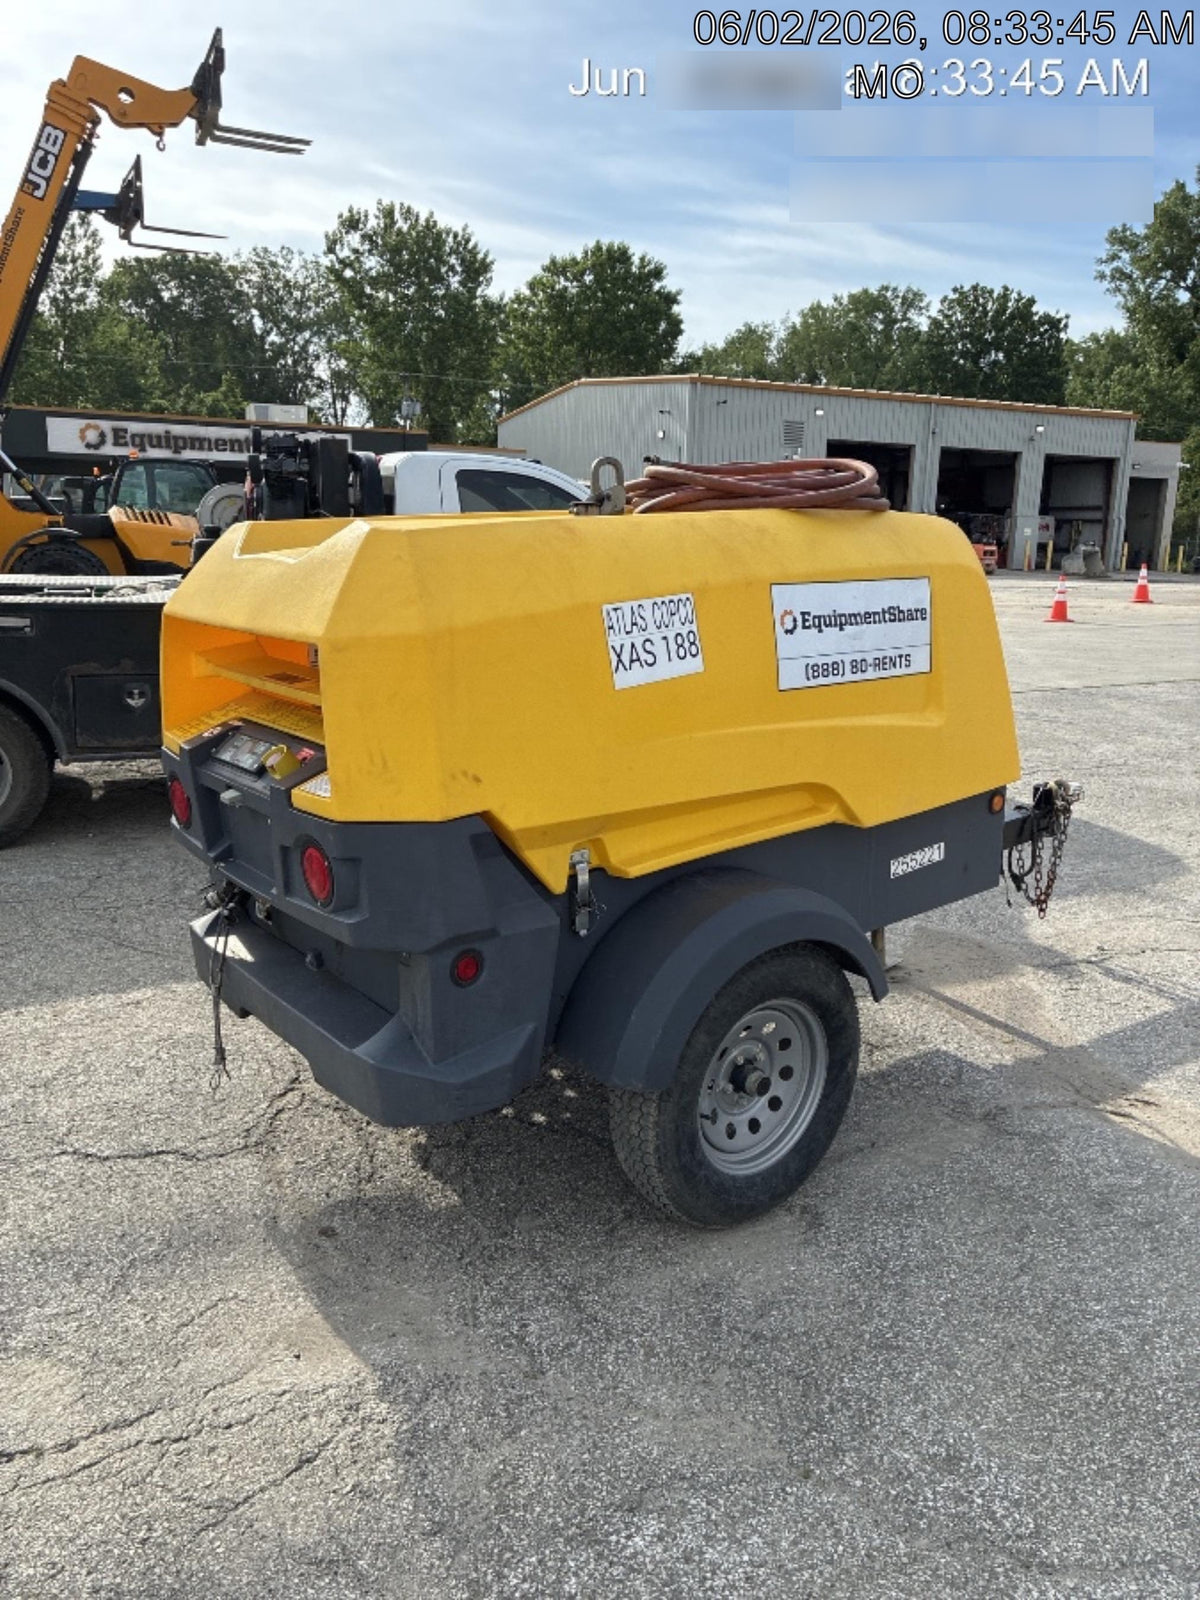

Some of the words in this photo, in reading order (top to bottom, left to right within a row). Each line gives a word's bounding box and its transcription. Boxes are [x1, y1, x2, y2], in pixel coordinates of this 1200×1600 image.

[27, 125, 65, 199] JCB
[606, 603, 648, 637] ATLAS
[652, 597, 694, 630] COPCO
[800, 605, 927, 633] EquipmentShare
[611, 638, 657, 674] XAS
[661, 630, 699, 662] 188
[805, 660, 845, 681] (888)
[850, 654, 911, 675] 80-RENTS
